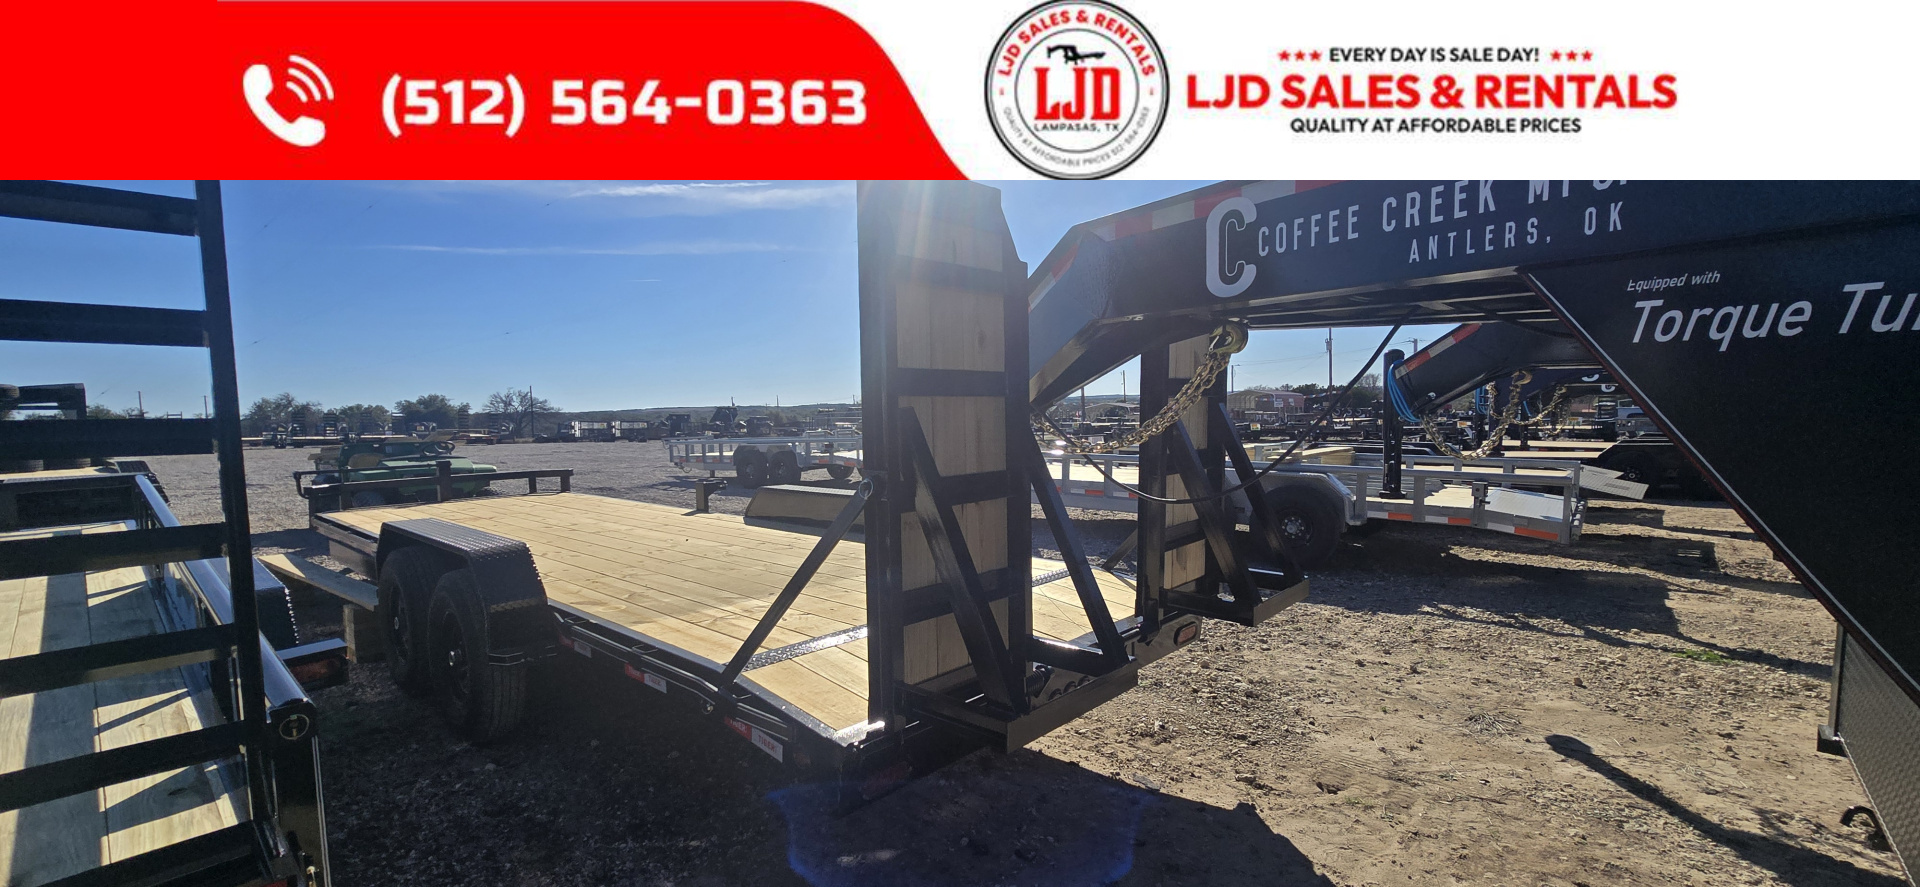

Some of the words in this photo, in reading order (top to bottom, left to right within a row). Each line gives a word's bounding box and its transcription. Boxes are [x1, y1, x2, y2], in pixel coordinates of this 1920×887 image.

[1258, 204, 1360, 257] COFFEE
[1382, 180, 1496, 232] CREEK
[1408, 217, 1551, 264] ANTLERS,
[1584, 201, 1624, 236] OK
[1627, 272, 1689, 293] Equipped
[1691, 270, 1721, 286] with
[1632, 299, 1813, 352] Torque
[1838, 281, 1920, 334] Tu
